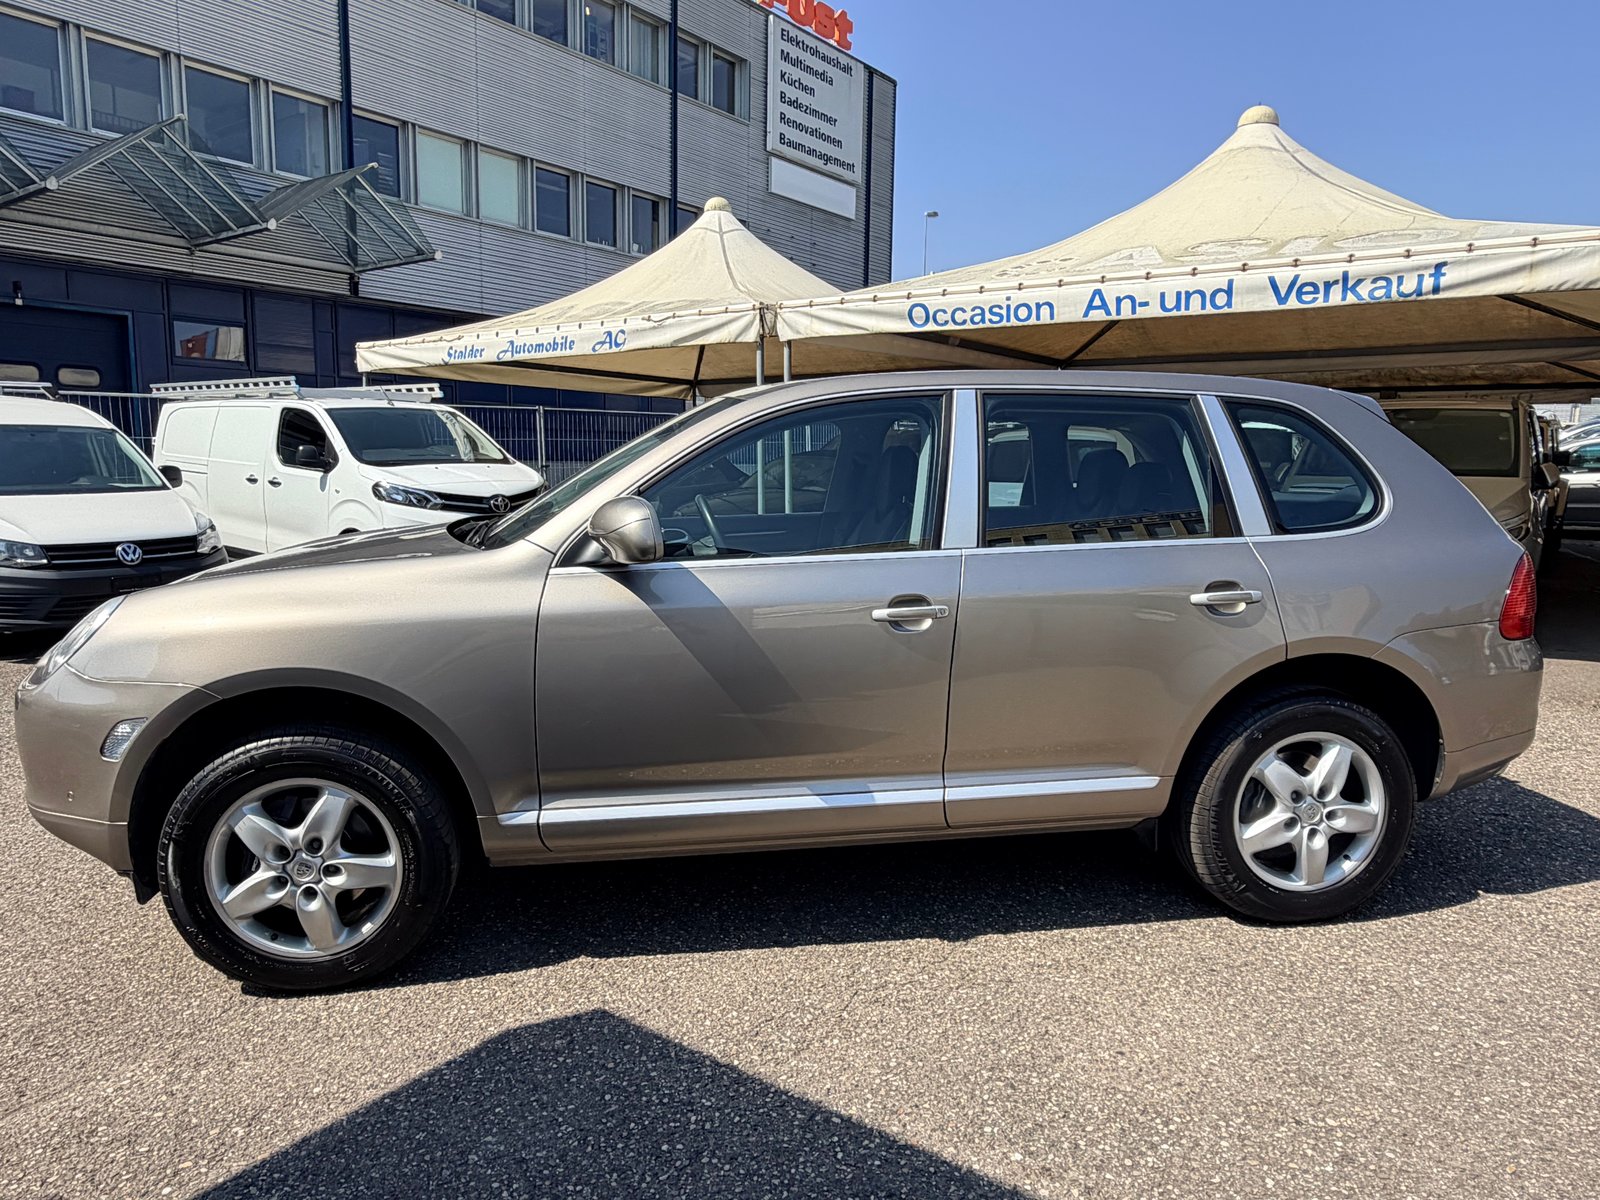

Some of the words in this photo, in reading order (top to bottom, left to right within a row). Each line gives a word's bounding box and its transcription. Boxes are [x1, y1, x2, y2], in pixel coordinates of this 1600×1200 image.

[780, 28, 853, 77] Elektrohaushalt
[780, 49, 834, 87] Multimedia
[780, 69, 816, 97] Küchen
[779, 91, 838, 128] Badezimmer
[779, 111, 843, 149] Renovationen
[779, 132, 856, 173] Baumanagement
[907, 297, 1055, 328] Occasion
[1082, 288, 1151, 319] An-
[1158, 279, 1234, 313] und
[1268, 261, 1448, 307] Verkauf
[442, 345, 485, 365] Stalder
[496, 335, 576, 361] Automobile
[591, 329, 627, 353] AG
[118, 543, 142, 564] VW
